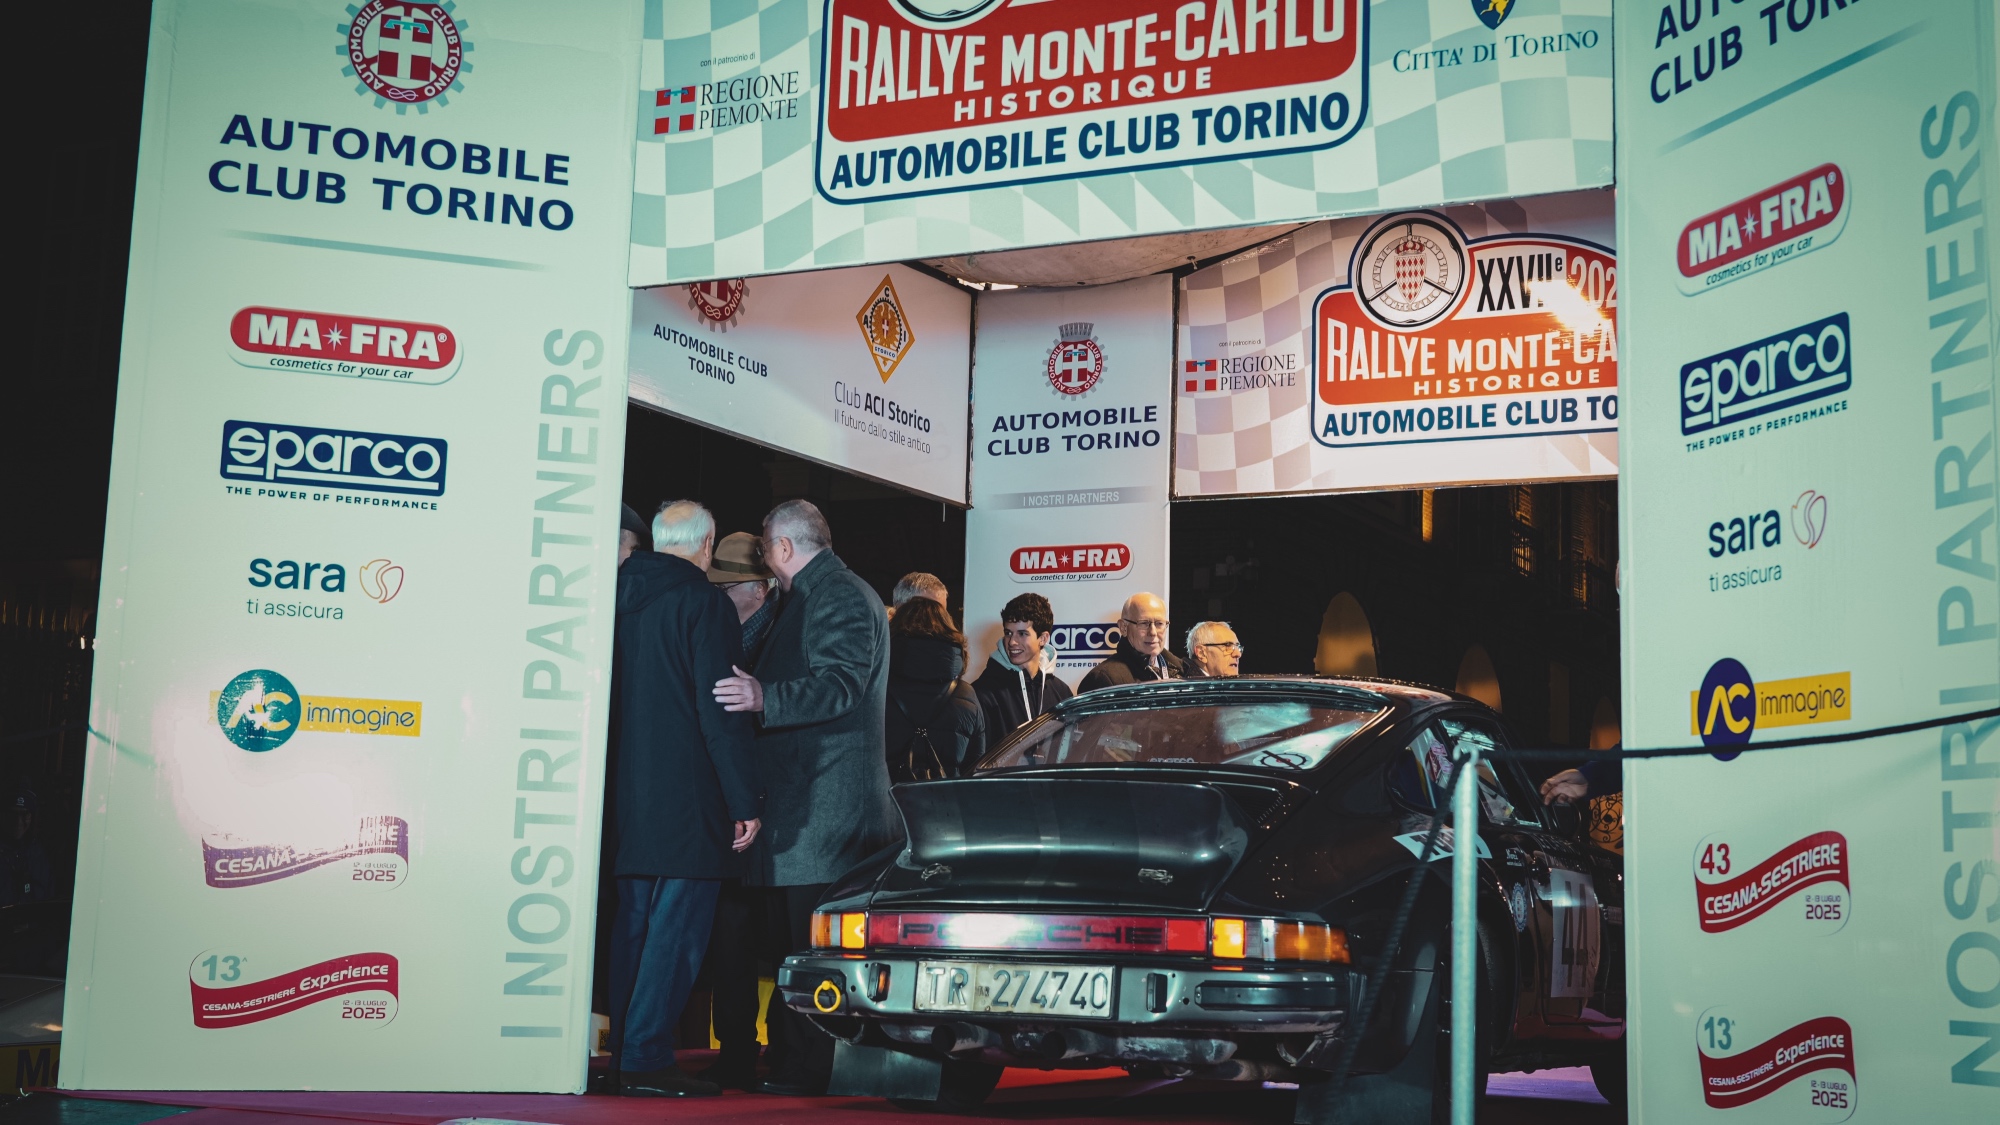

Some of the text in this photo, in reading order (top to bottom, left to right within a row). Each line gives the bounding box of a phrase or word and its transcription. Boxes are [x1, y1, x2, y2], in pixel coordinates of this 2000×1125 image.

[431, 7, 459, 45] CLUB
[424, 47, 460, 97] TORINO
[839, 0, 1345, 110] RALLYE MONTE-CARLO
[1650, 25, 1743, 104] CLUB
[700, 71, 799, 106] REGIONE
[953, 66, 1212, 123] HISTORIQUE
[698, 98, 798, 130] PIEMONTE
[220, 114, 570, 187] AUTOMOBILE
[829, 91, 1350, 191] AUTOMOBILE CLUB TORINO
[208, 160, 575, 231] CLUB TORINO
[1706, 236, 1813, 285] cosmetics for your car
[724, 279, 743, 316] ORINO
[1571, 256, 1617, 308] 202
[270, 357, 414, 379] cosmetics for your car
[653, 323, 768, 378] AUTOMOBILE CLUB
[1220, 354, 1296, 374] REGIONE
[1326, 317, 1617, 383] RALLYE MONTE-CA
[1920, 90, 1998, 646] PARTNERS
[688, 356, 736, 385] TORINO
[1220, 373, 1296, 391] PIEMONTE
[1413, 368, 1600, 396] HISTORIQUE
[1684, 324, 1846, 425] sparco
[834, 381, 931, 433] Club ACI Storico
[992, 405, 1157, 433] AUTOMOBILE
[1322, 402, 1497, 438] AUTOMOBILE
[1505, 397, 1579, 426] CLUB
[1686, 400, 1848, 452] THE POWER OF PERFORMANCE
[841, 411, 866, 433] futuro
[889, 430, 905, 446] stile
[907, 437, 931, 454] antico
[988, 430, 1160, 457] CLUB TORINO
[228, 427, 441, 481] sparco
[226, 486, 438, 511] THE POWER OF PERFORMANCE
[522, 328, 605, 700] PARTNERS
[1029, 495, 1065, 506] NOSTRI
[1067, 491, 1119, 503] PARTNERS
[1708, 508, 1781, 558] sara
[247, 557, 346, 593] sara
[1031, 573, 1064, 581] cosmetics
[1077, 573, 1094, 582] your
[1709, 563, 1782, 592] ti assicura
[246, 599, 344, 620] ti assicura
[1050, 626, 1121, 650] arco
[307, 702, 416, 731] immagine
[1760, 685, 1846, 719] immagine
[352, 869, 396, 882] 2025
[503, 728, 584, 997] NOSTRI
[1700, 843, 1730, 875] 43
[1704, 843, 1841, 915] CESANA-SESTRIERE
[1805, 904, 1842, 920] 2025
[1562, 881, 1588, 987] 44
[203, 965, 389, 1011] CESANA-SESTRIERE Experience
[926, 966, 1109, 1010] TR 274740
[342, 1007, 386, 1019] 2025
[500, 1025, 564, 1038] I
[1709, 1034, 1845, 1086] CESANA-SESTRIERE Experience
[1812, 1090, 1848, 1109] 2025
